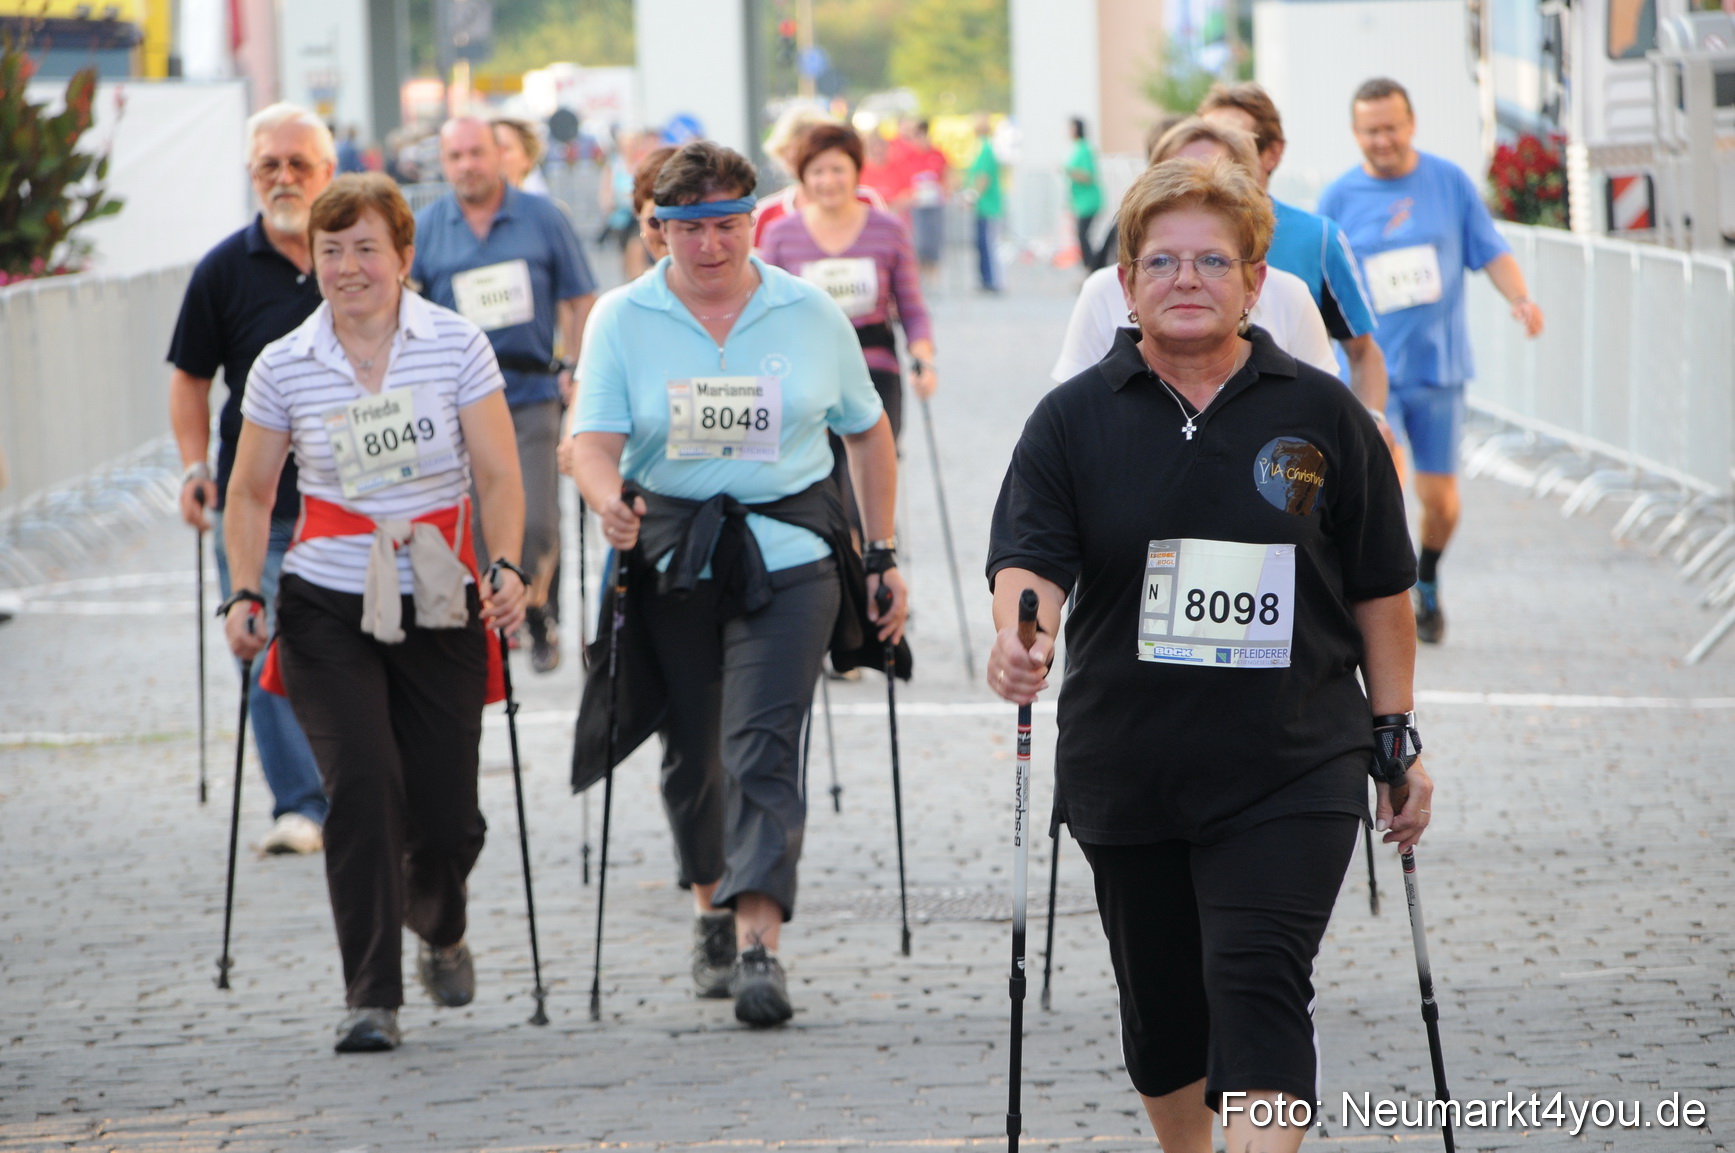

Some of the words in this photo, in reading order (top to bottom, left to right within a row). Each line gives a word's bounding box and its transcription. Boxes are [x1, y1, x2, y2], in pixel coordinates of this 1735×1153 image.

[697, 383, 764, 397] Marianne
[352, 399, 401, 424] Frieda
[702, 406, 769, 431] 8048
[364, 417, 435, 456] 8049
[1149, 584, 1159, 600] N
[1185, 588, 1280, 626] 8098
[1233, 648, 1288, 659] PFLEIDERER
